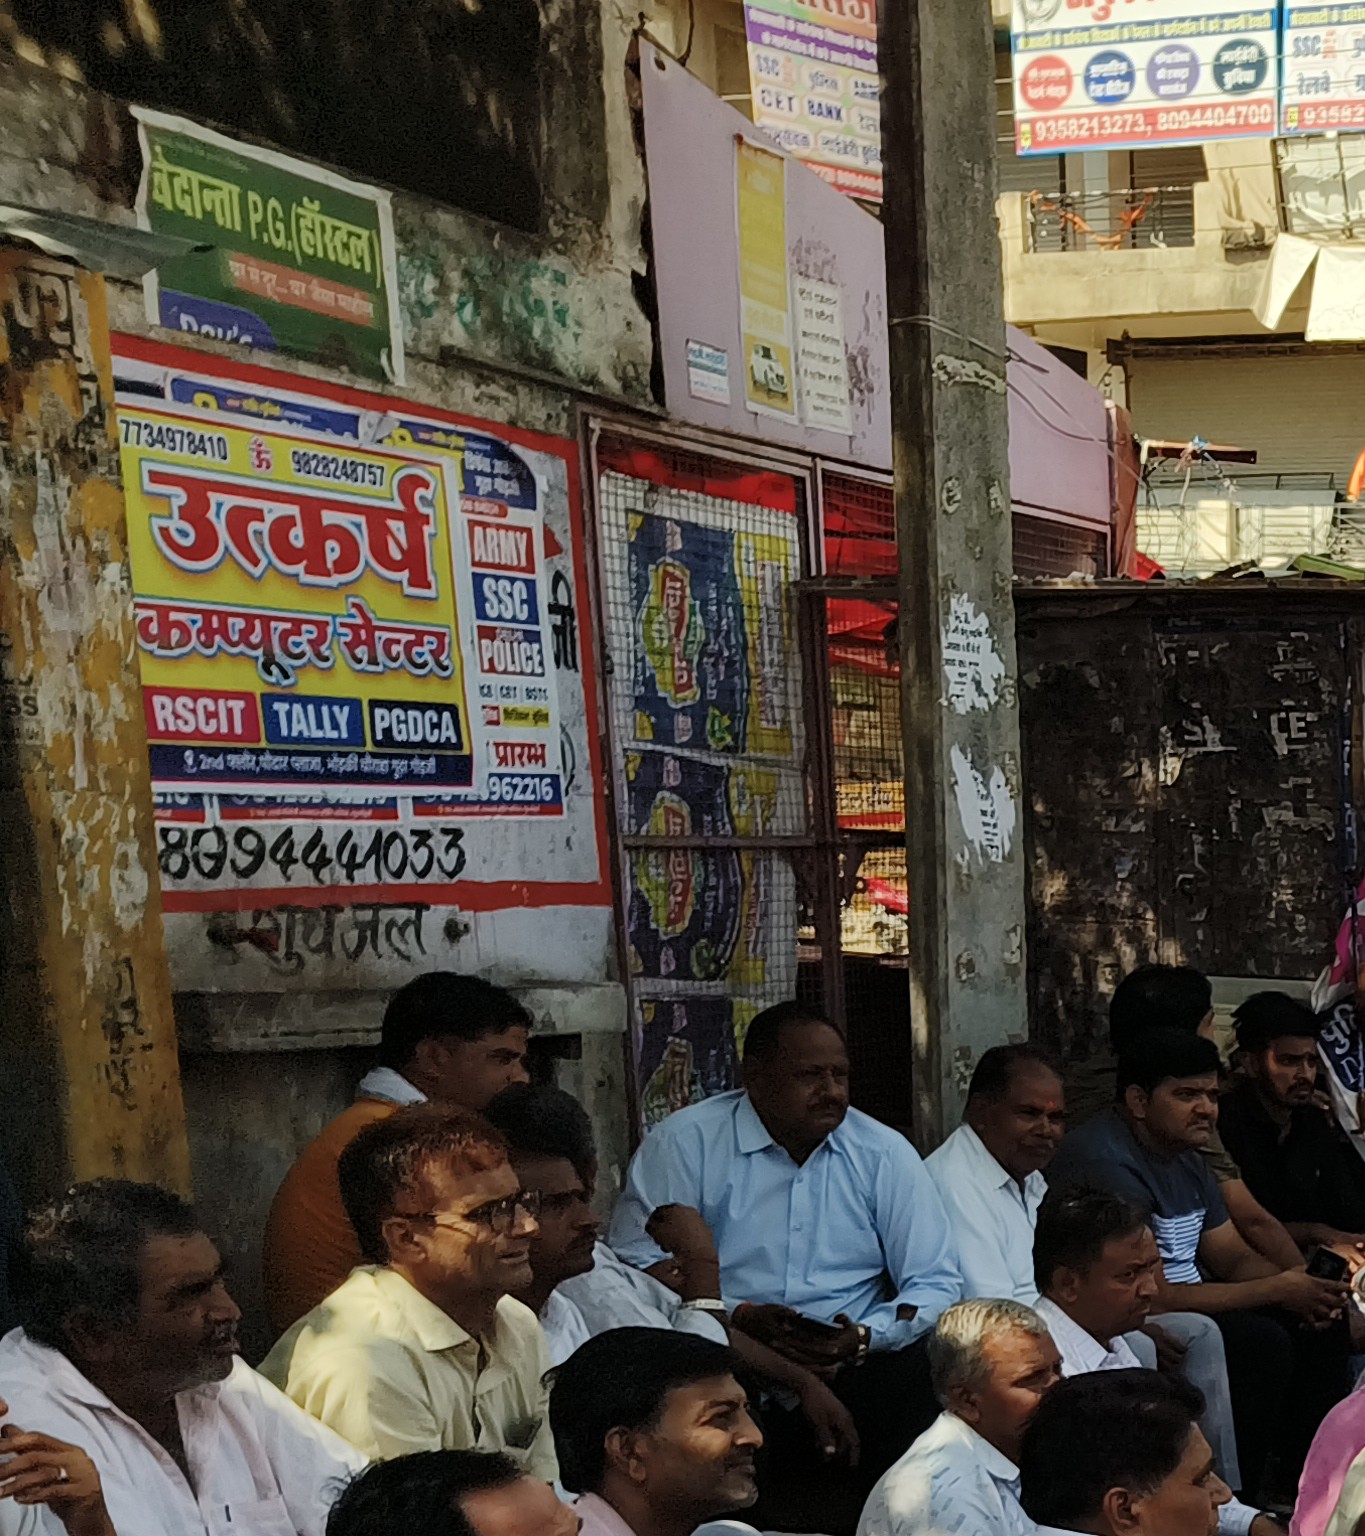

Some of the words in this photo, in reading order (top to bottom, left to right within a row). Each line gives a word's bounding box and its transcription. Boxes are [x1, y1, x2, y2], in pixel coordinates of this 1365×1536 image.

[807, 99, 844, 122] BANK
[152, 145, 242, 232] वेदान्ता
[119, 417, 229, 462] 7734978410
[291, 448, 386, 488] 9828248757
[147, 470, 434, 593] उत्कर्ष
[473, 525, 528, 568] ARMY
[482, 576, 530, 621] SSC
[337, 599, 453, 675] सेन्टर
[480, 637, 545, 675] POLICE
[151, 693, 246, 736] RSCIT
[271, 701, 351, 740] TALLY
[373, 706, 458, 744] PGDCA
